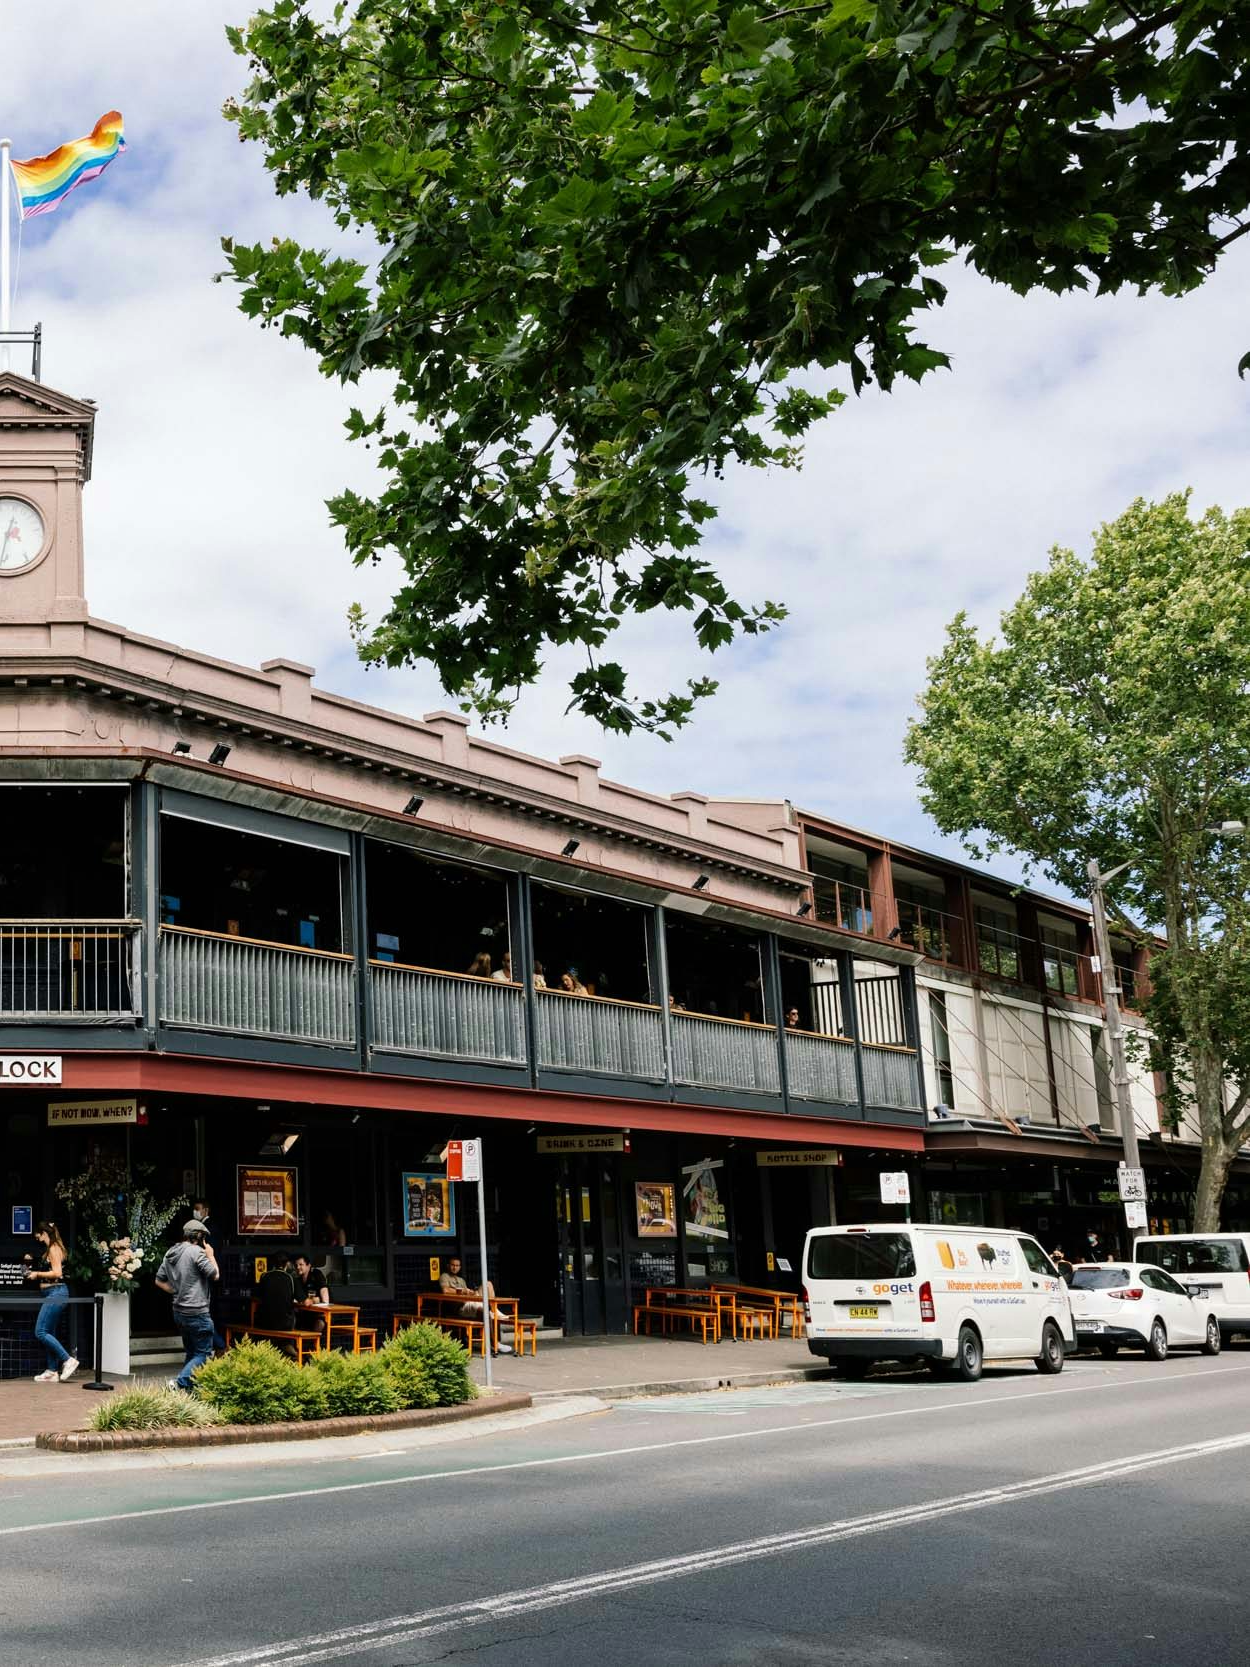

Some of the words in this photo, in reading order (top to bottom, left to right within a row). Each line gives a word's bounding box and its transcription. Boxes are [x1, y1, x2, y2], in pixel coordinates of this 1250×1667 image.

[52, 1109, 60, 1119] IF
[61, 1108, 79, 1119] NOT
[102, 1105, 133, 1117] WHEN?
[803, 1153, 827, 1162] SHOP
[872, 1282, 915, 1296] goget
[860, 1308, 868, 1316] 44
